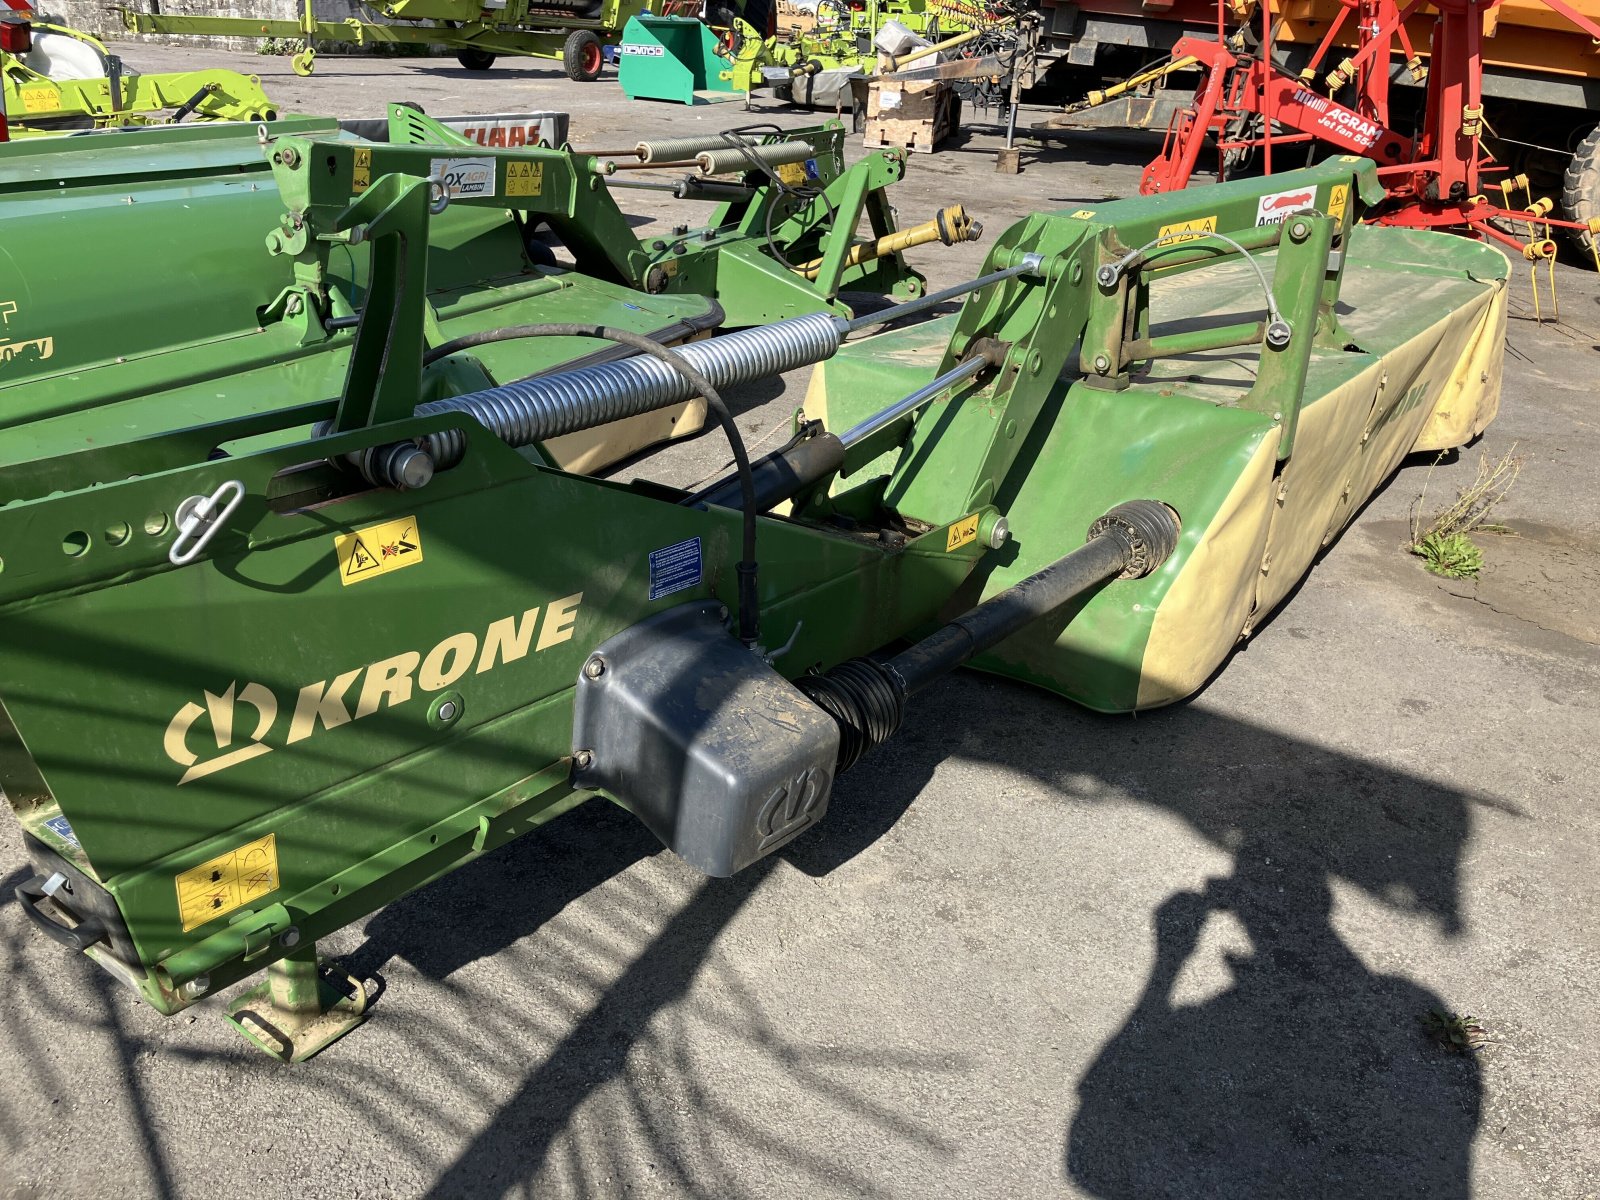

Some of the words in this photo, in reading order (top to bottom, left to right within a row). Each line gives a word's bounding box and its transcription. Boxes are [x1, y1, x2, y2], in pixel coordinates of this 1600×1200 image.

[1317, 116, 1335, 131] Jet
[1335, 124, 1354, 139] fan
[1353, 132, 1376, 149] 554
[1326, 108, 1384, 142] AGRAM
[461, 183, 486, 192] LAMBIN
[286, 591, 584, 746] KRONE
